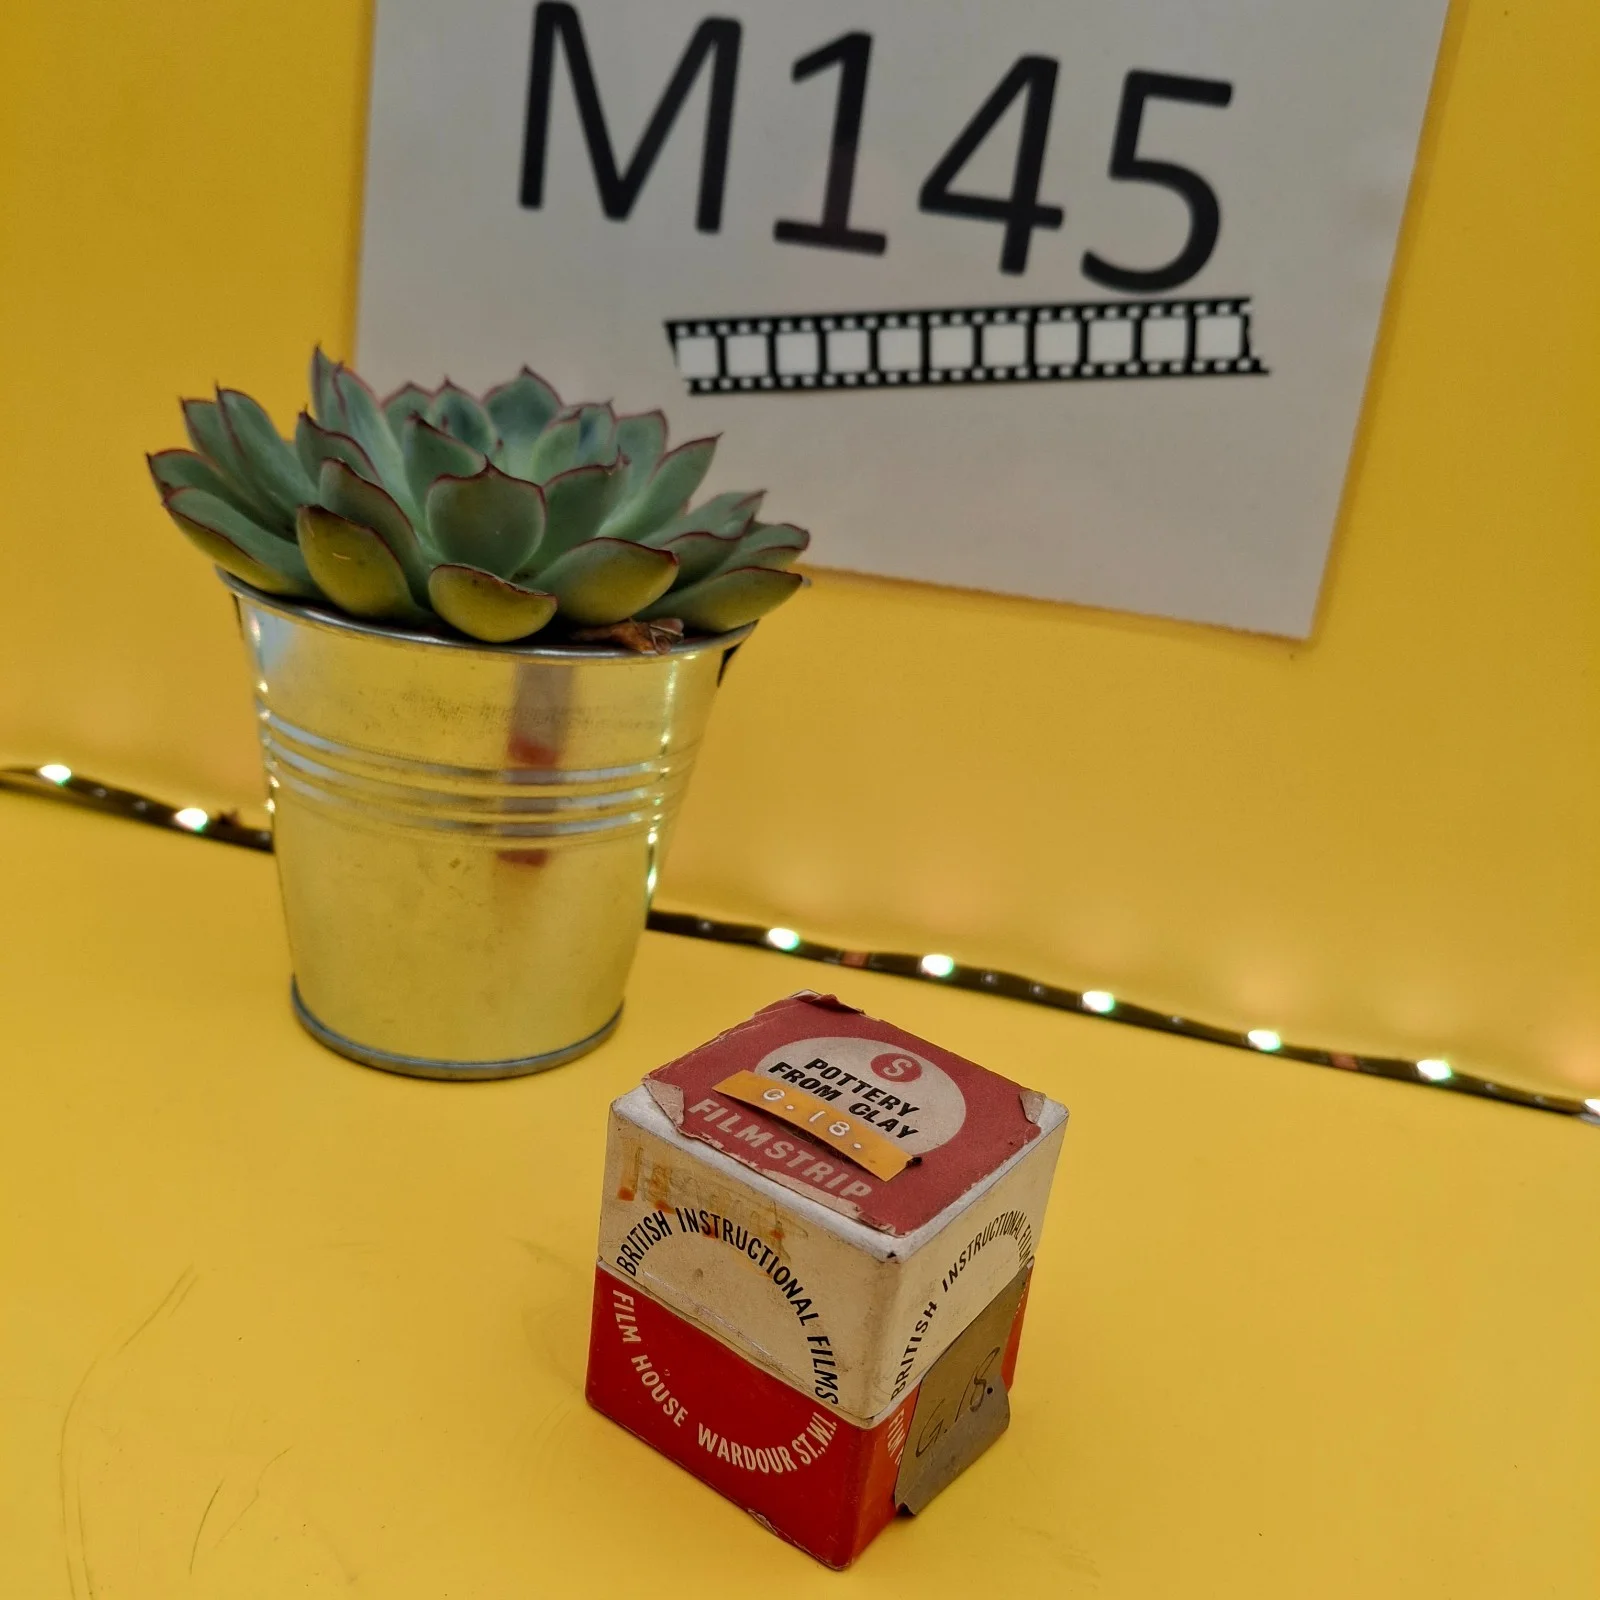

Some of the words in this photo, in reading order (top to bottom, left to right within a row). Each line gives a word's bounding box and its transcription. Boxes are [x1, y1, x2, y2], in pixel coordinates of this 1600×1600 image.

[518, 1, 1234, 295] M145
[767, 1061, 842, 1102] FROM
[848, 1103, 919, 1139] CLAY
[803, 1057, 920, 1118] POTTERY
[882, 1057, 905, 1078] S
[687, 1098, 874, 1200] FILMSTRIP
[616, 1209, 673, 1277] BRITISH
[675, 1207, 820, 1327] INSTRUCTIONAL
[807, 1335, 839, 1406] FILMS
[891, 1301, 938, 1401] BRITISH
[941, 1210, 1027, 1293] INSTRUCTIONAL
[612, 1289, 642, 1344] FILM
[631, 1354, 689, 1428] HOUSE
[698, 1422, 798, 1475] WARDOUR
[887, 1408, 906, 1458] FILM
